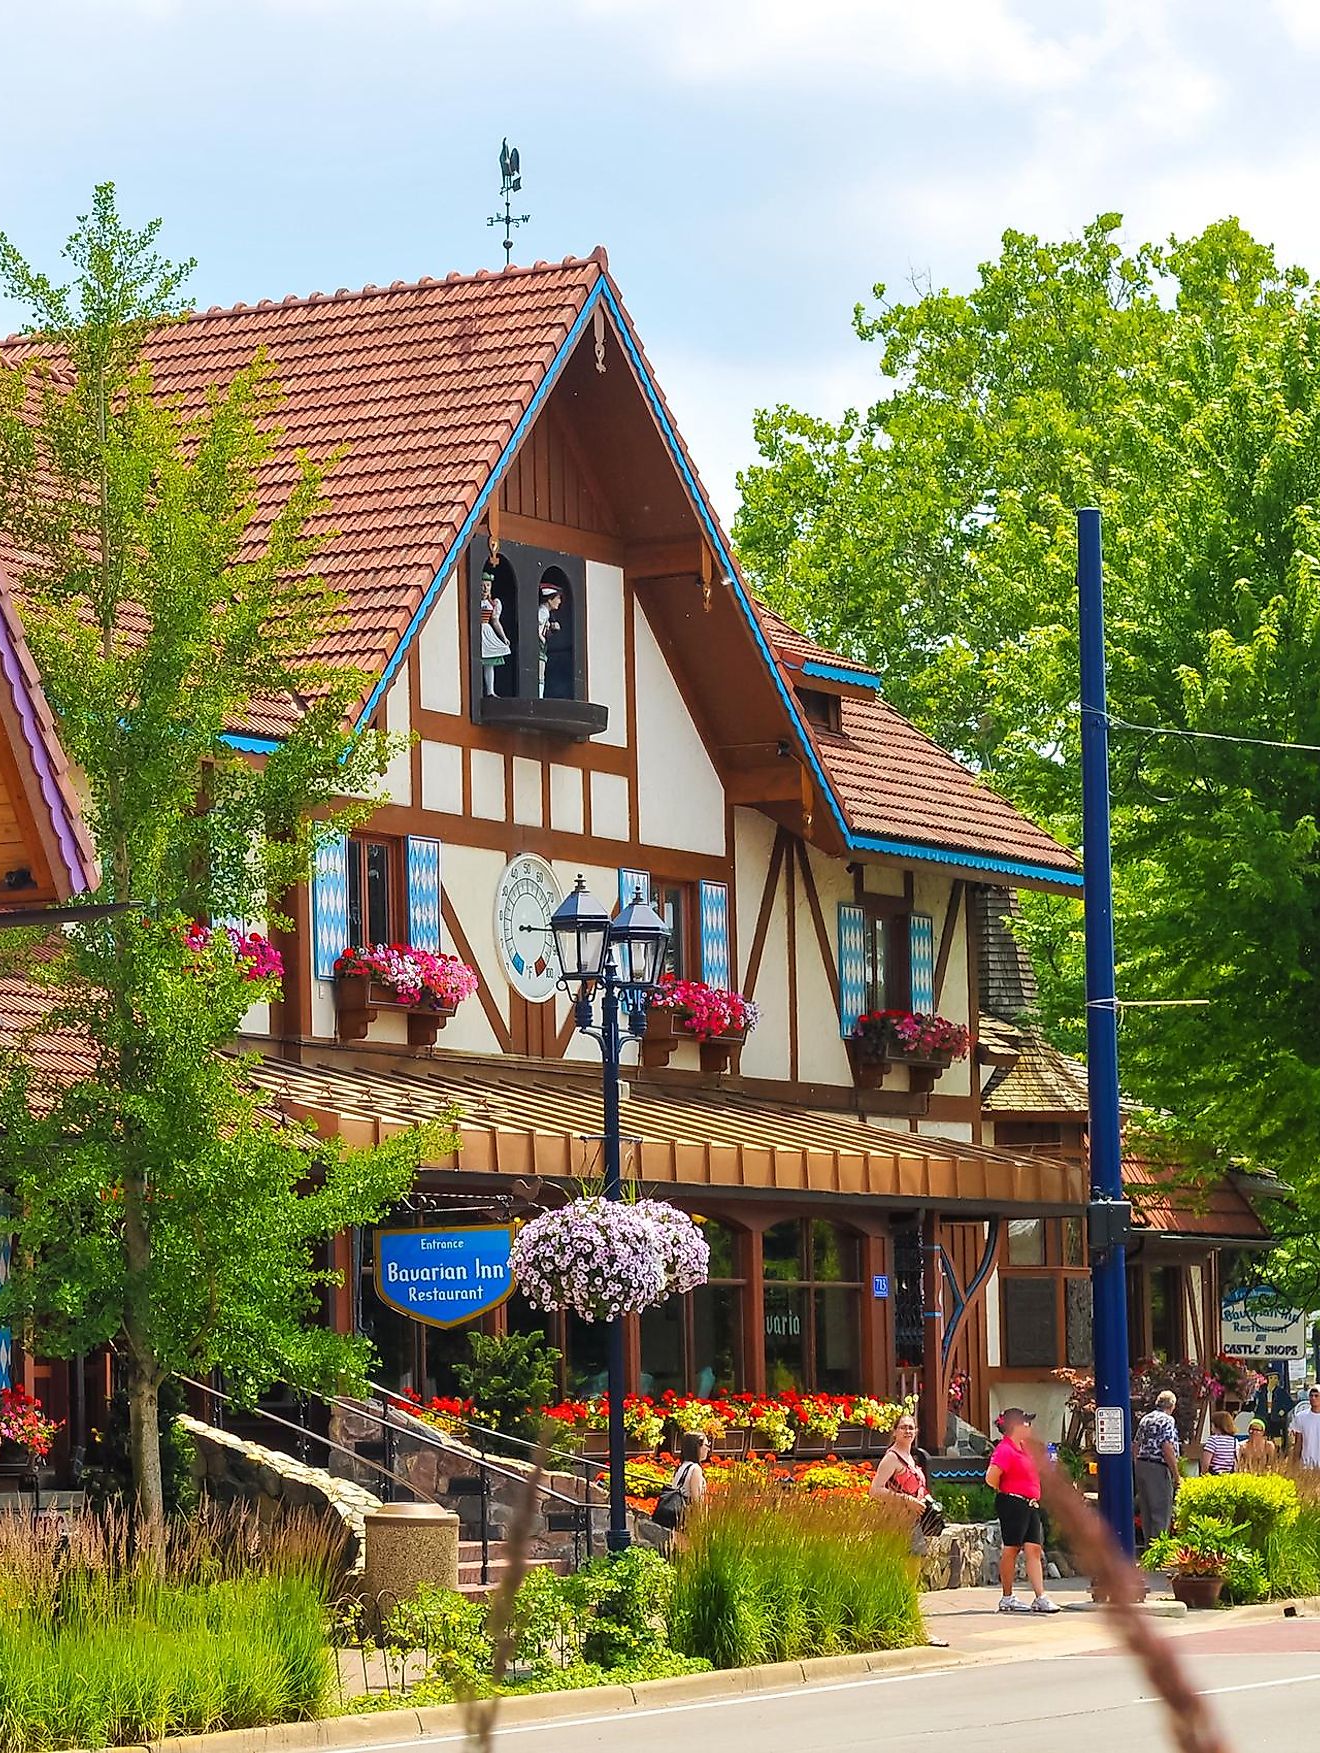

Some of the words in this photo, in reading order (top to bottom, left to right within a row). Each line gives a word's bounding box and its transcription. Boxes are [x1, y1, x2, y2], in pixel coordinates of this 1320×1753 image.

[420, 1238, 464, 1250] Entrance
[387, 1261, 468, 1283] Bavarian
[475, 1257, 505, 1279] Inn
[408, 1285, 484, 1302] Restaurant
[1223, 1344, 1261, 1355] CASTLE
[1264, 1344, 1298, 1356] SHOPS
